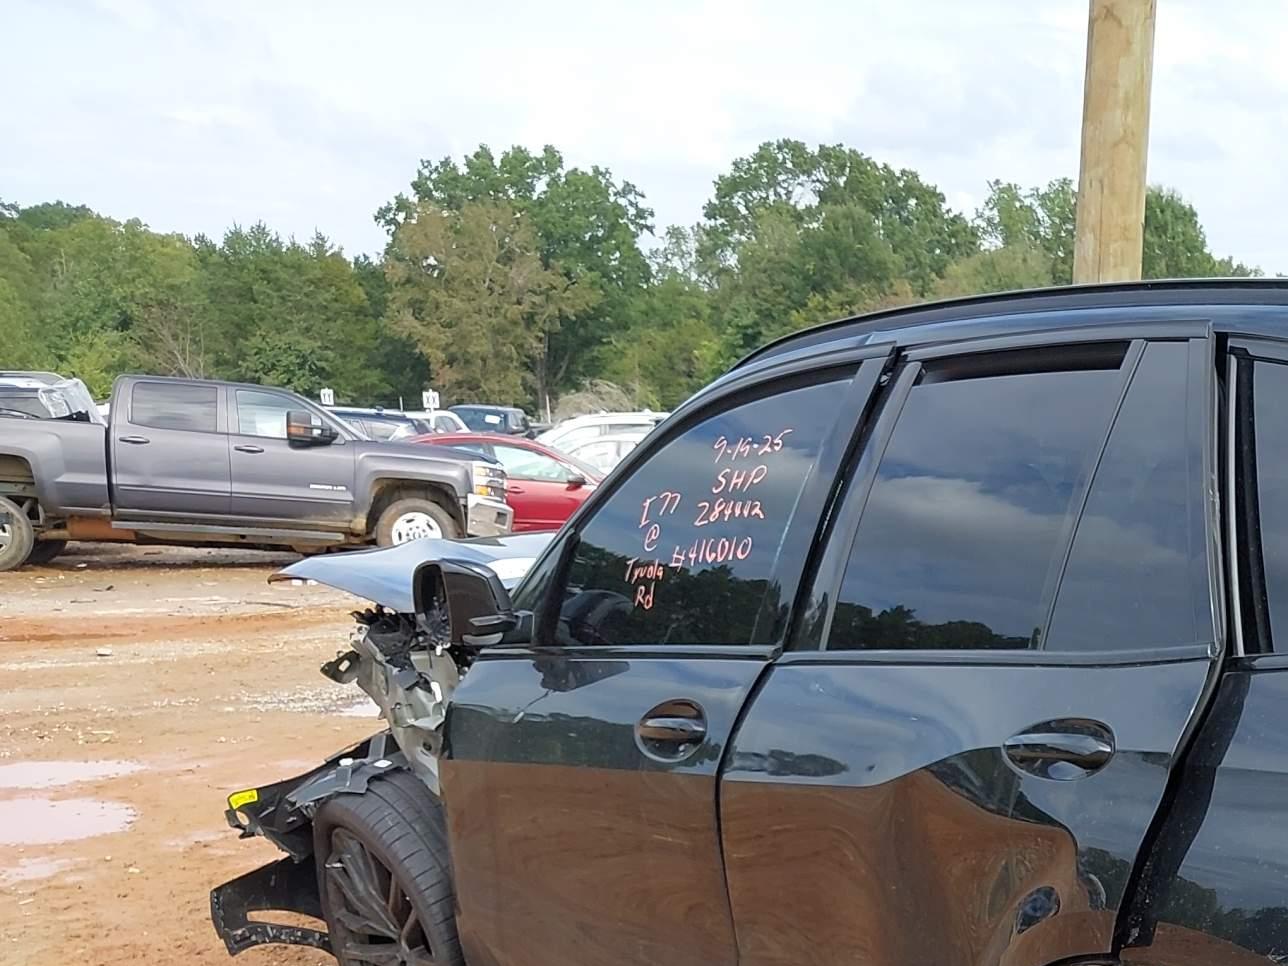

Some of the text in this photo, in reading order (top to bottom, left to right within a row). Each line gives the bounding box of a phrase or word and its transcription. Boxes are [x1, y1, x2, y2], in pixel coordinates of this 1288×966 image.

[712, 465, 768, 494] SHP
[644, 524, 661, 552] @
[634, 581, 656, 610] Rd
